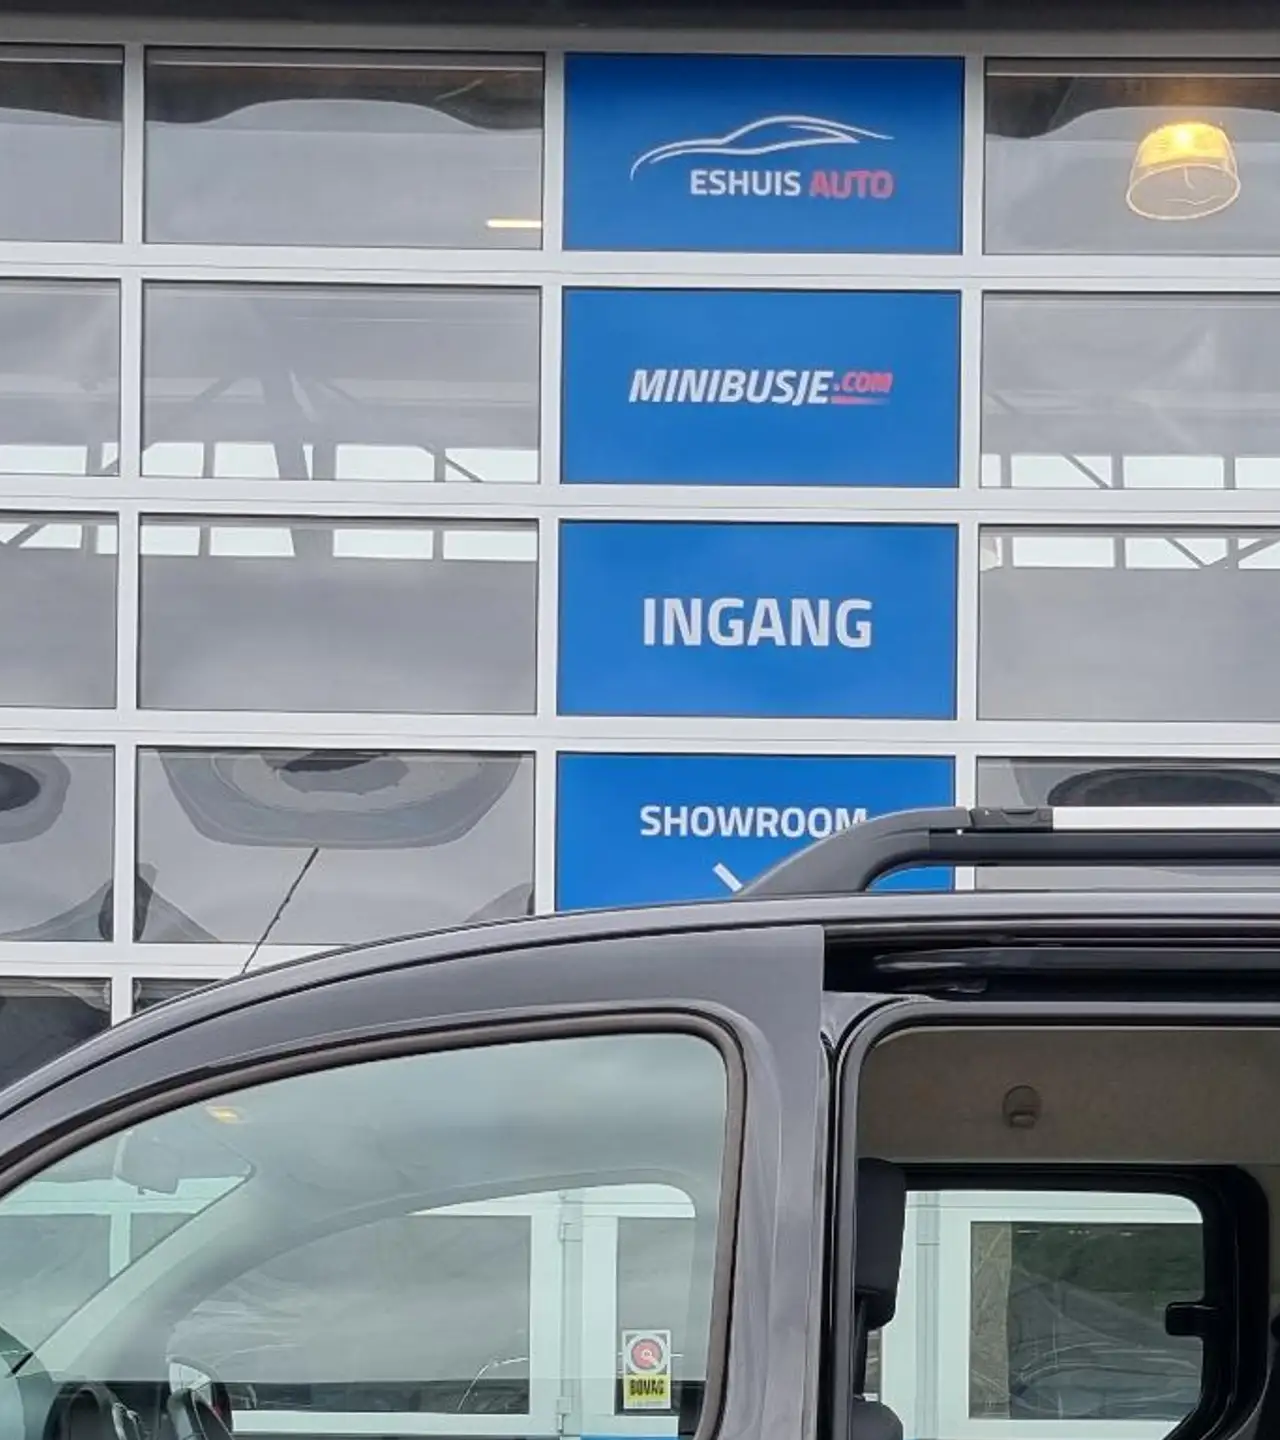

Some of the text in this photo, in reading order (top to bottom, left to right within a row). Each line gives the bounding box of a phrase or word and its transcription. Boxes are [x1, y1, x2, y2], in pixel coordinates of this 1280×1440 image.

[690, 169, 894, 199] ESHUIS AUTO
[643, 597, 873, 648] INGANG
[639, 804, 867, 839] SHOWROOM
